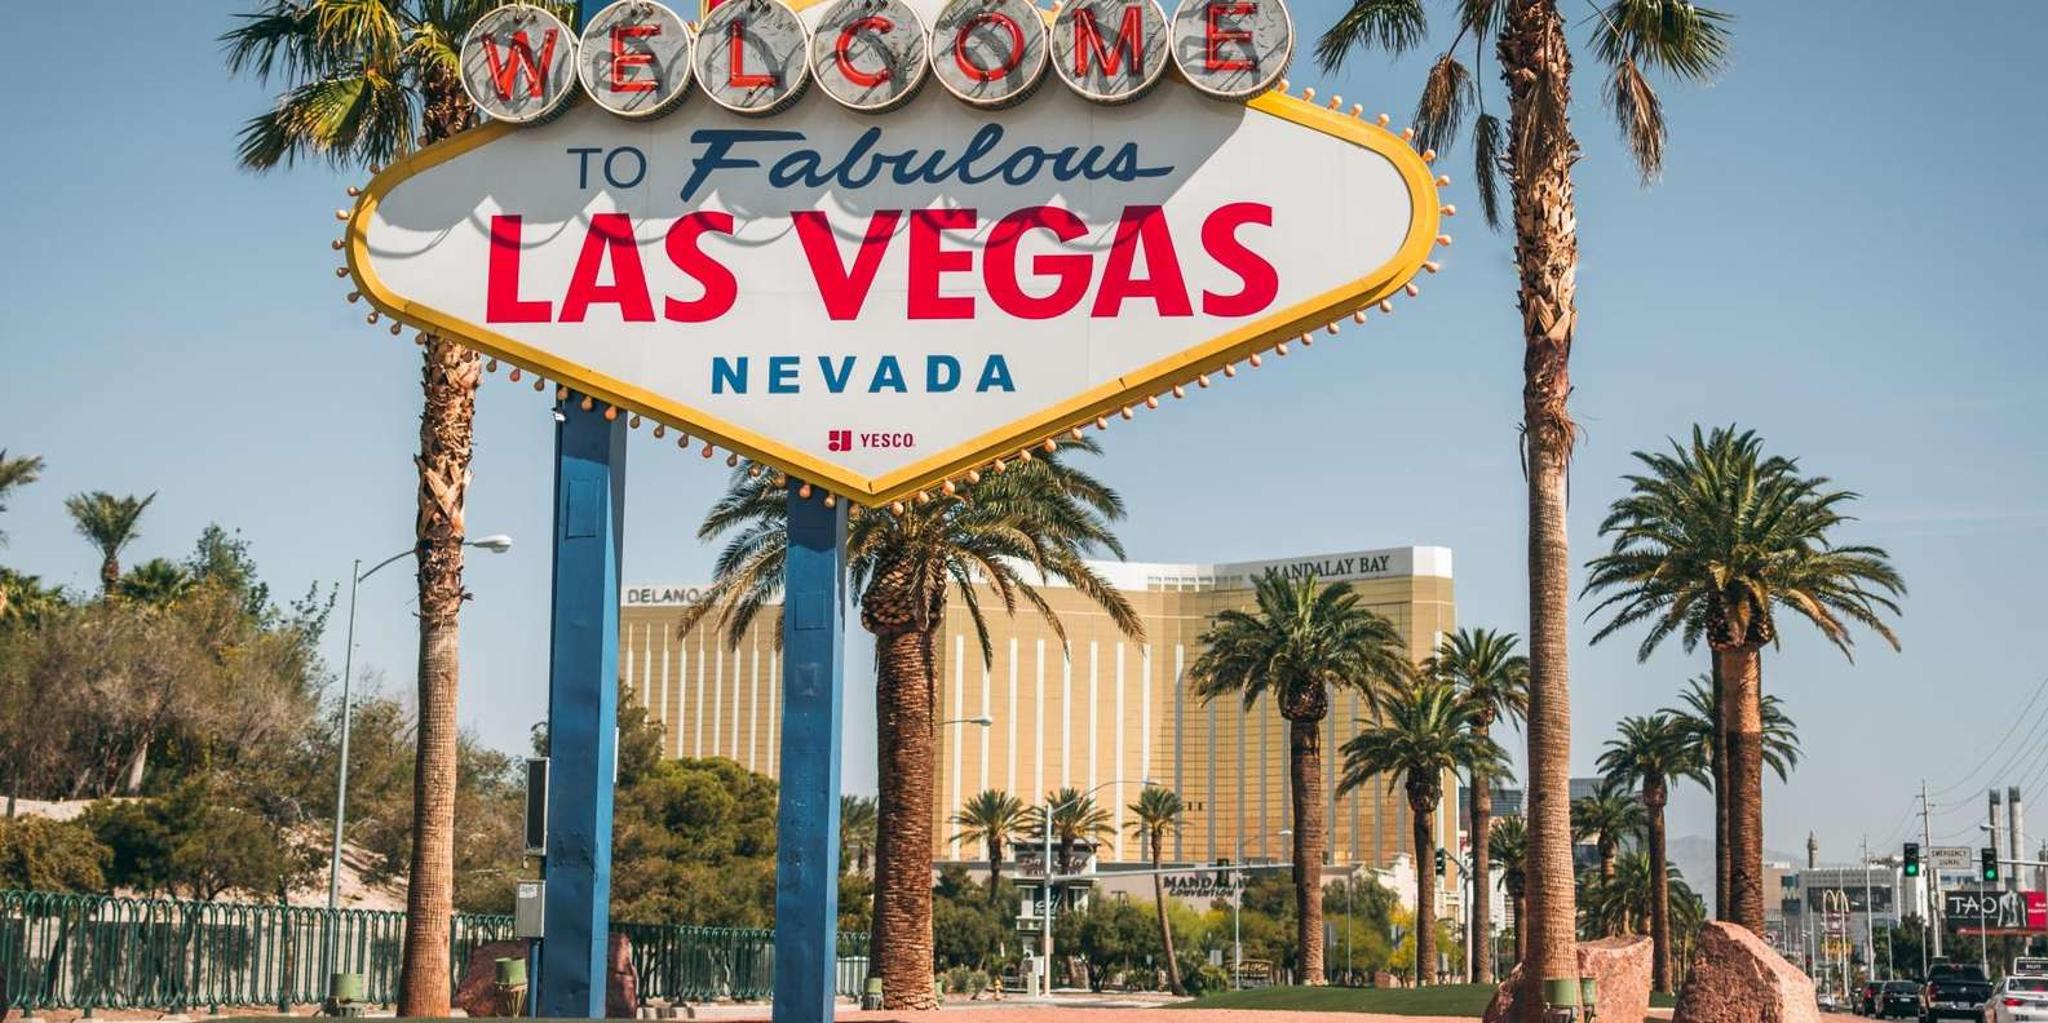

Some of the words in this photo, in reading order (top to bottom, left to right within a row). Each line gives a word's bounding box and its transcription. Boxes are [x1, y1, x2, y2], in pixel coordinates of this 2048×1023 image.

[481, 3, 1257, 100] WELCOME
[567, 146, 646, 189] TO
[680, 123, 1174, 202] Fabulous
[486, 210, 739, 324] LAS
[793, 202, 1280, 321] VEGAS
[711, 354, 1016, 395] NEVADA
[860, 433, 913, 448] YESCO
[1264, 559, 1354, 580] MANDALAY
[1360, 555, 1390, 573] BAY
[628, 588, 699, 603] DELANO
[1948, 896, 1997, 914] TAO
